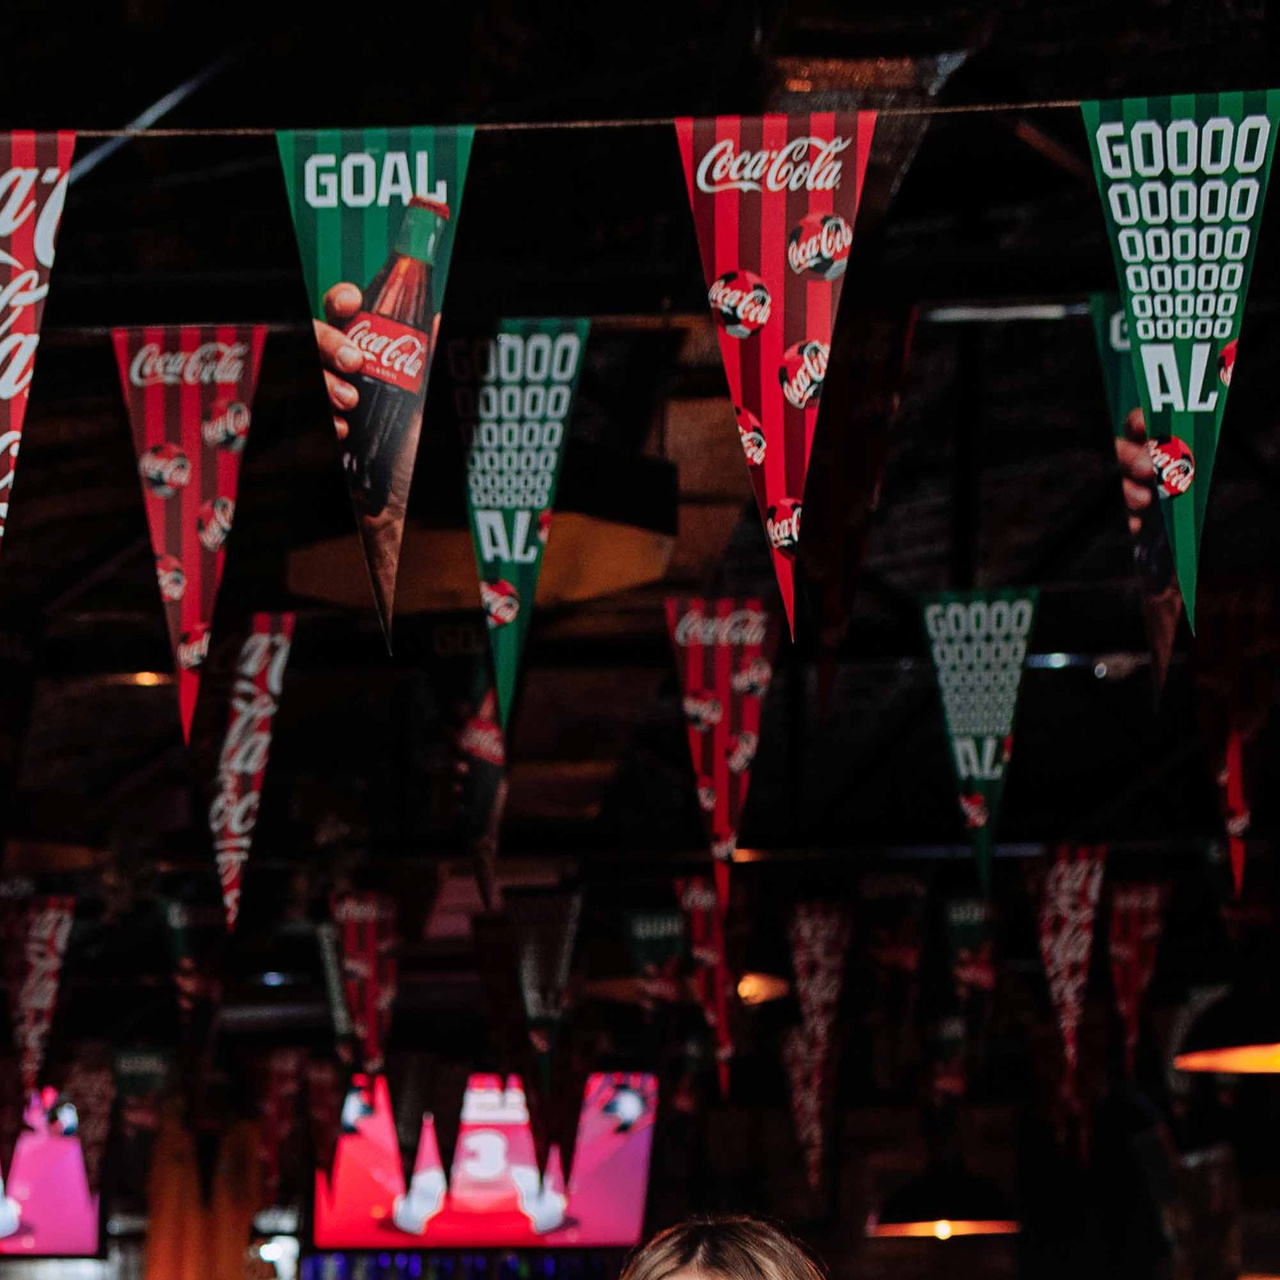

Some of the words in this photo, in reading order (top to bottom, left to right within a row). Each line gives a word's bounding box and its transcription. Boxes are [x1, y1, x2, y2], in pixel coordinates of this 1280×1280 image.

[696, 136, 853, 193] Coca-Cola
[1096, 115, 1270, 179] GOOOO
[304, 150, 448, 208] GOAL
[1140, 343, 1218, 412] AL
[475, 509, 539, 563] AL
[463, 1129, 508, 1181] 3
